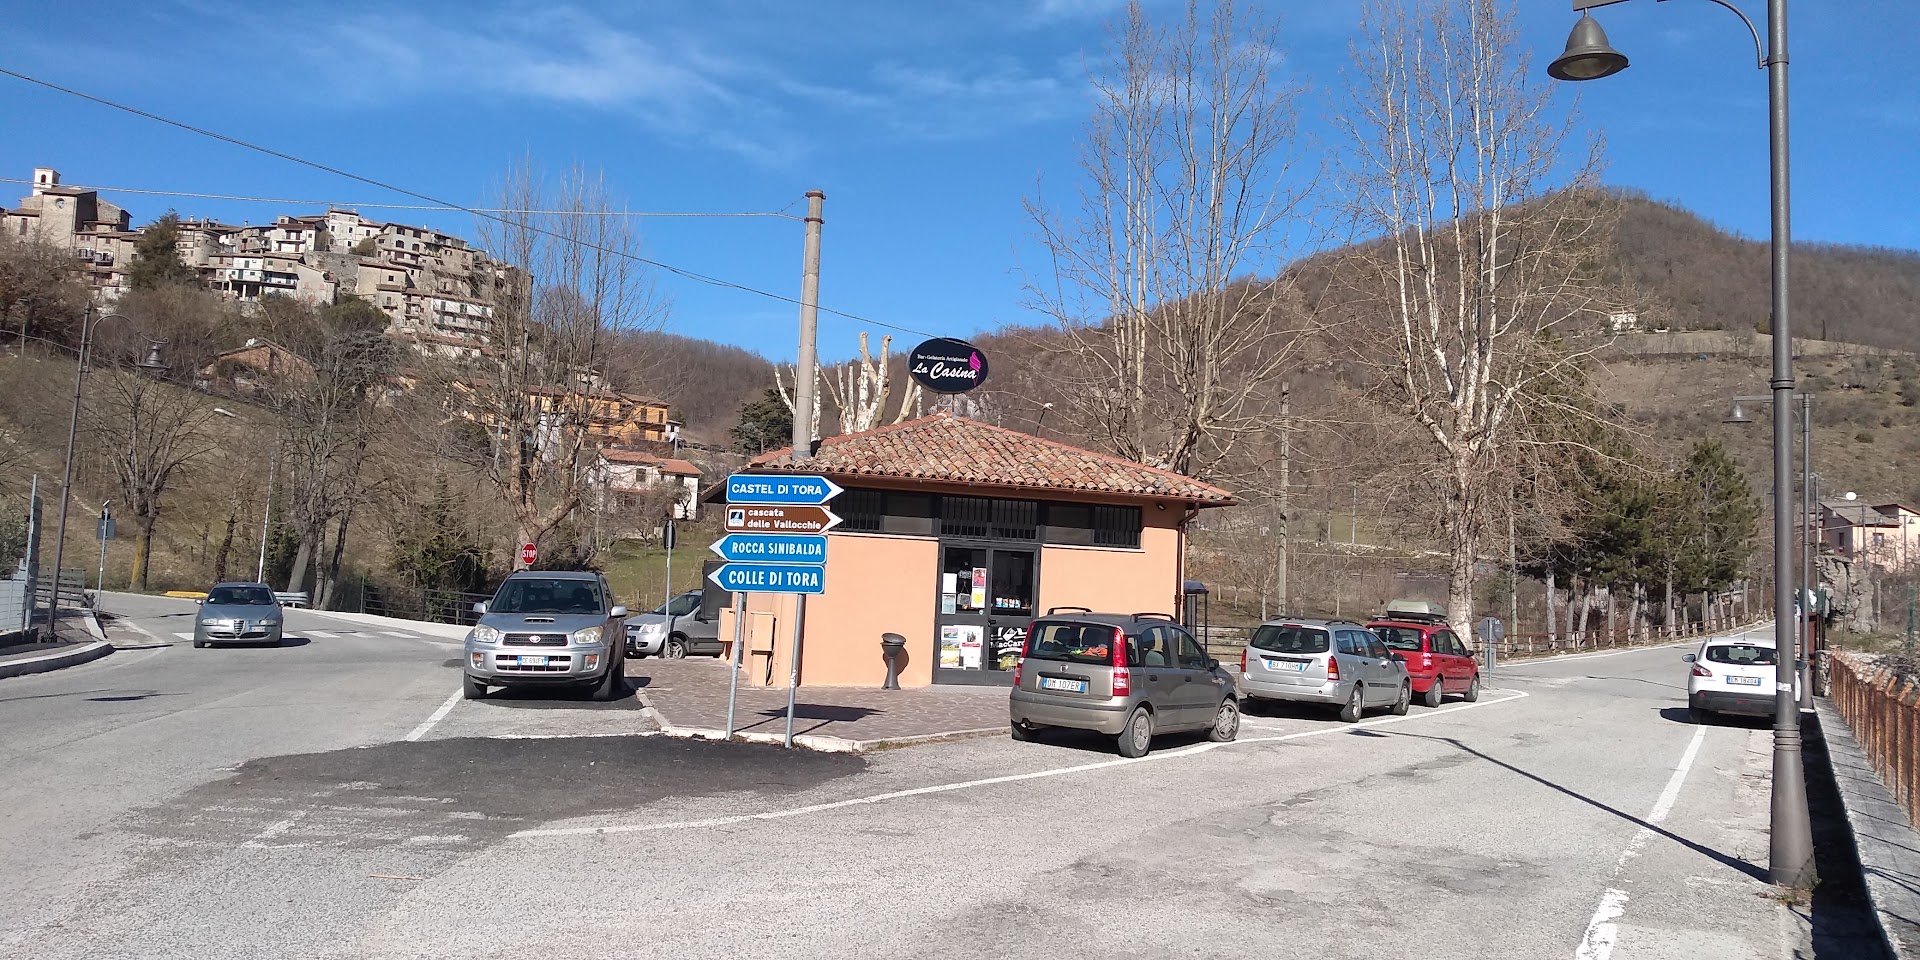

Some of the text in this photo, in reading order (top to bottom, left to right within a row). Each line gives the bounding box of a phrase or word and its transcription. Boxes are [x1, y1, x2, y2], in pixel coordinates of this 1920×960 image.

[912, 361, 977, 379] La Casina
[732, 483, 822, 496] CASTEL DI TORA
[748, 508, 784, 517] cascata
[747, 520, 822, 530] delle Vallocchie
[522, 549, 537, 559] STOP
[732, 542, 822, 556] ROCCA SINIBALDA
[728, 570, 819, 587] COLLE DI TORA
[1058, 680, 1080, 690] 107ER
